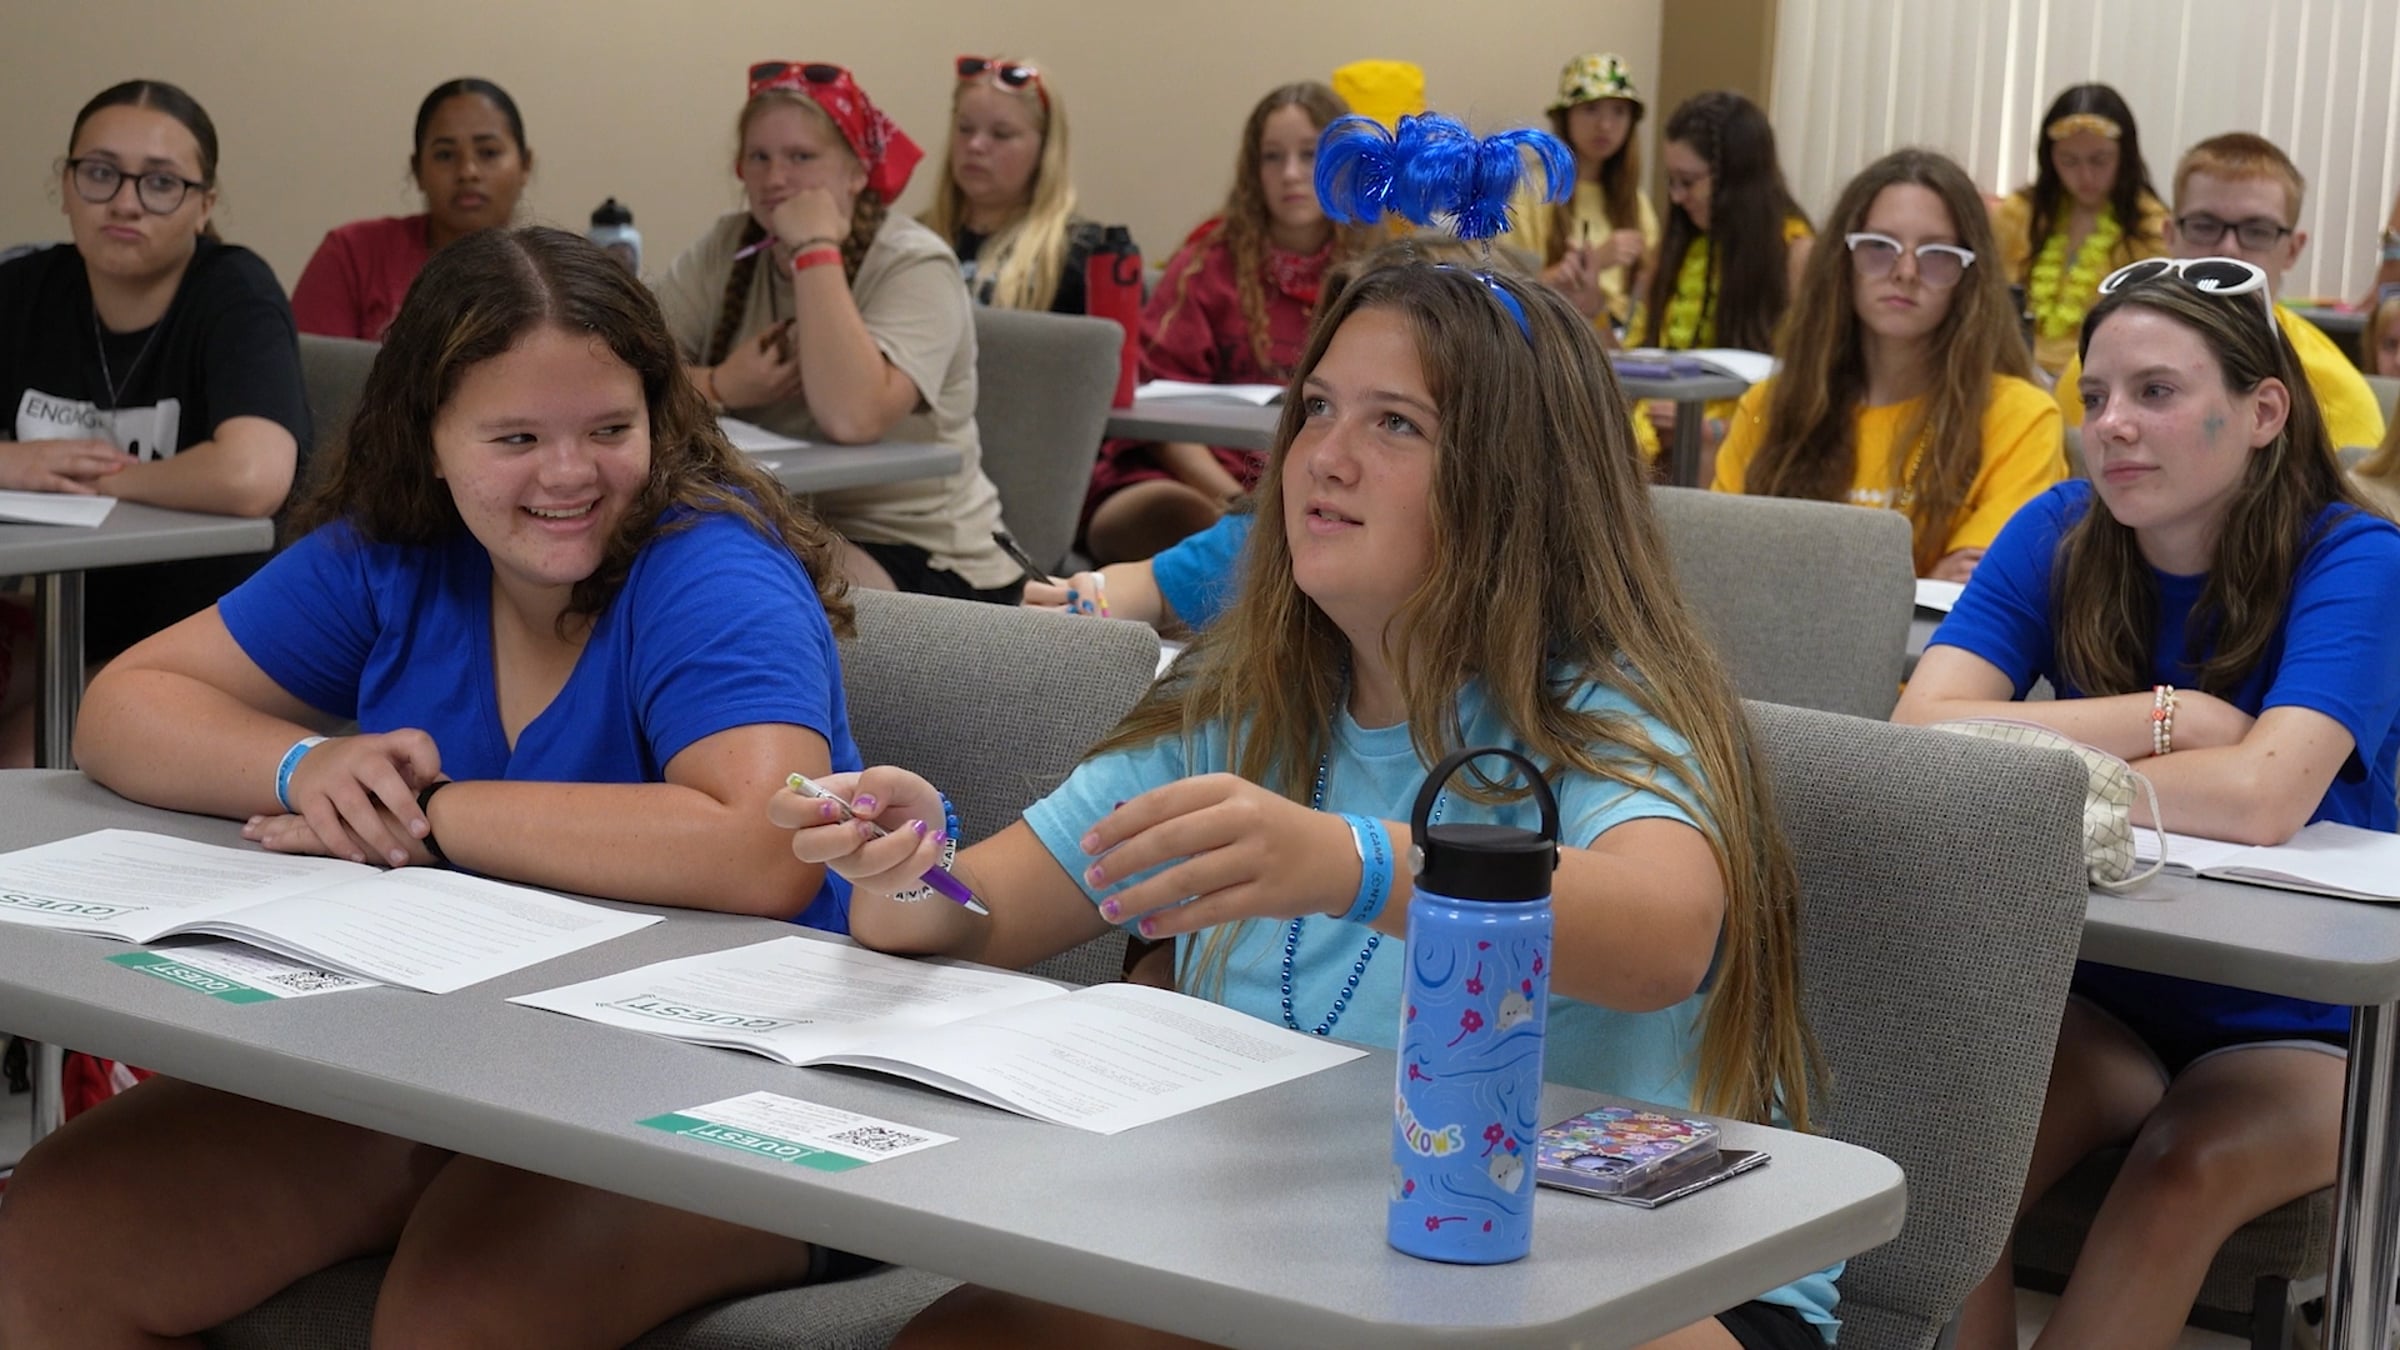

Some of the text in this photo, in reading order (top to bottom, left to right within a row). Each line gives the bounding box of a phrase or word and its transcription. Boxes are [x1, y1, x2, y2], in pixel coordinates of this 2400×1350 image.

[1369, 831, 1385, 866] CAMP
[152, 964, 231, 990] QUEST
[629, 1001, 779, 1028] QUEST
[698, 1123, 801, 1157] QUEST
